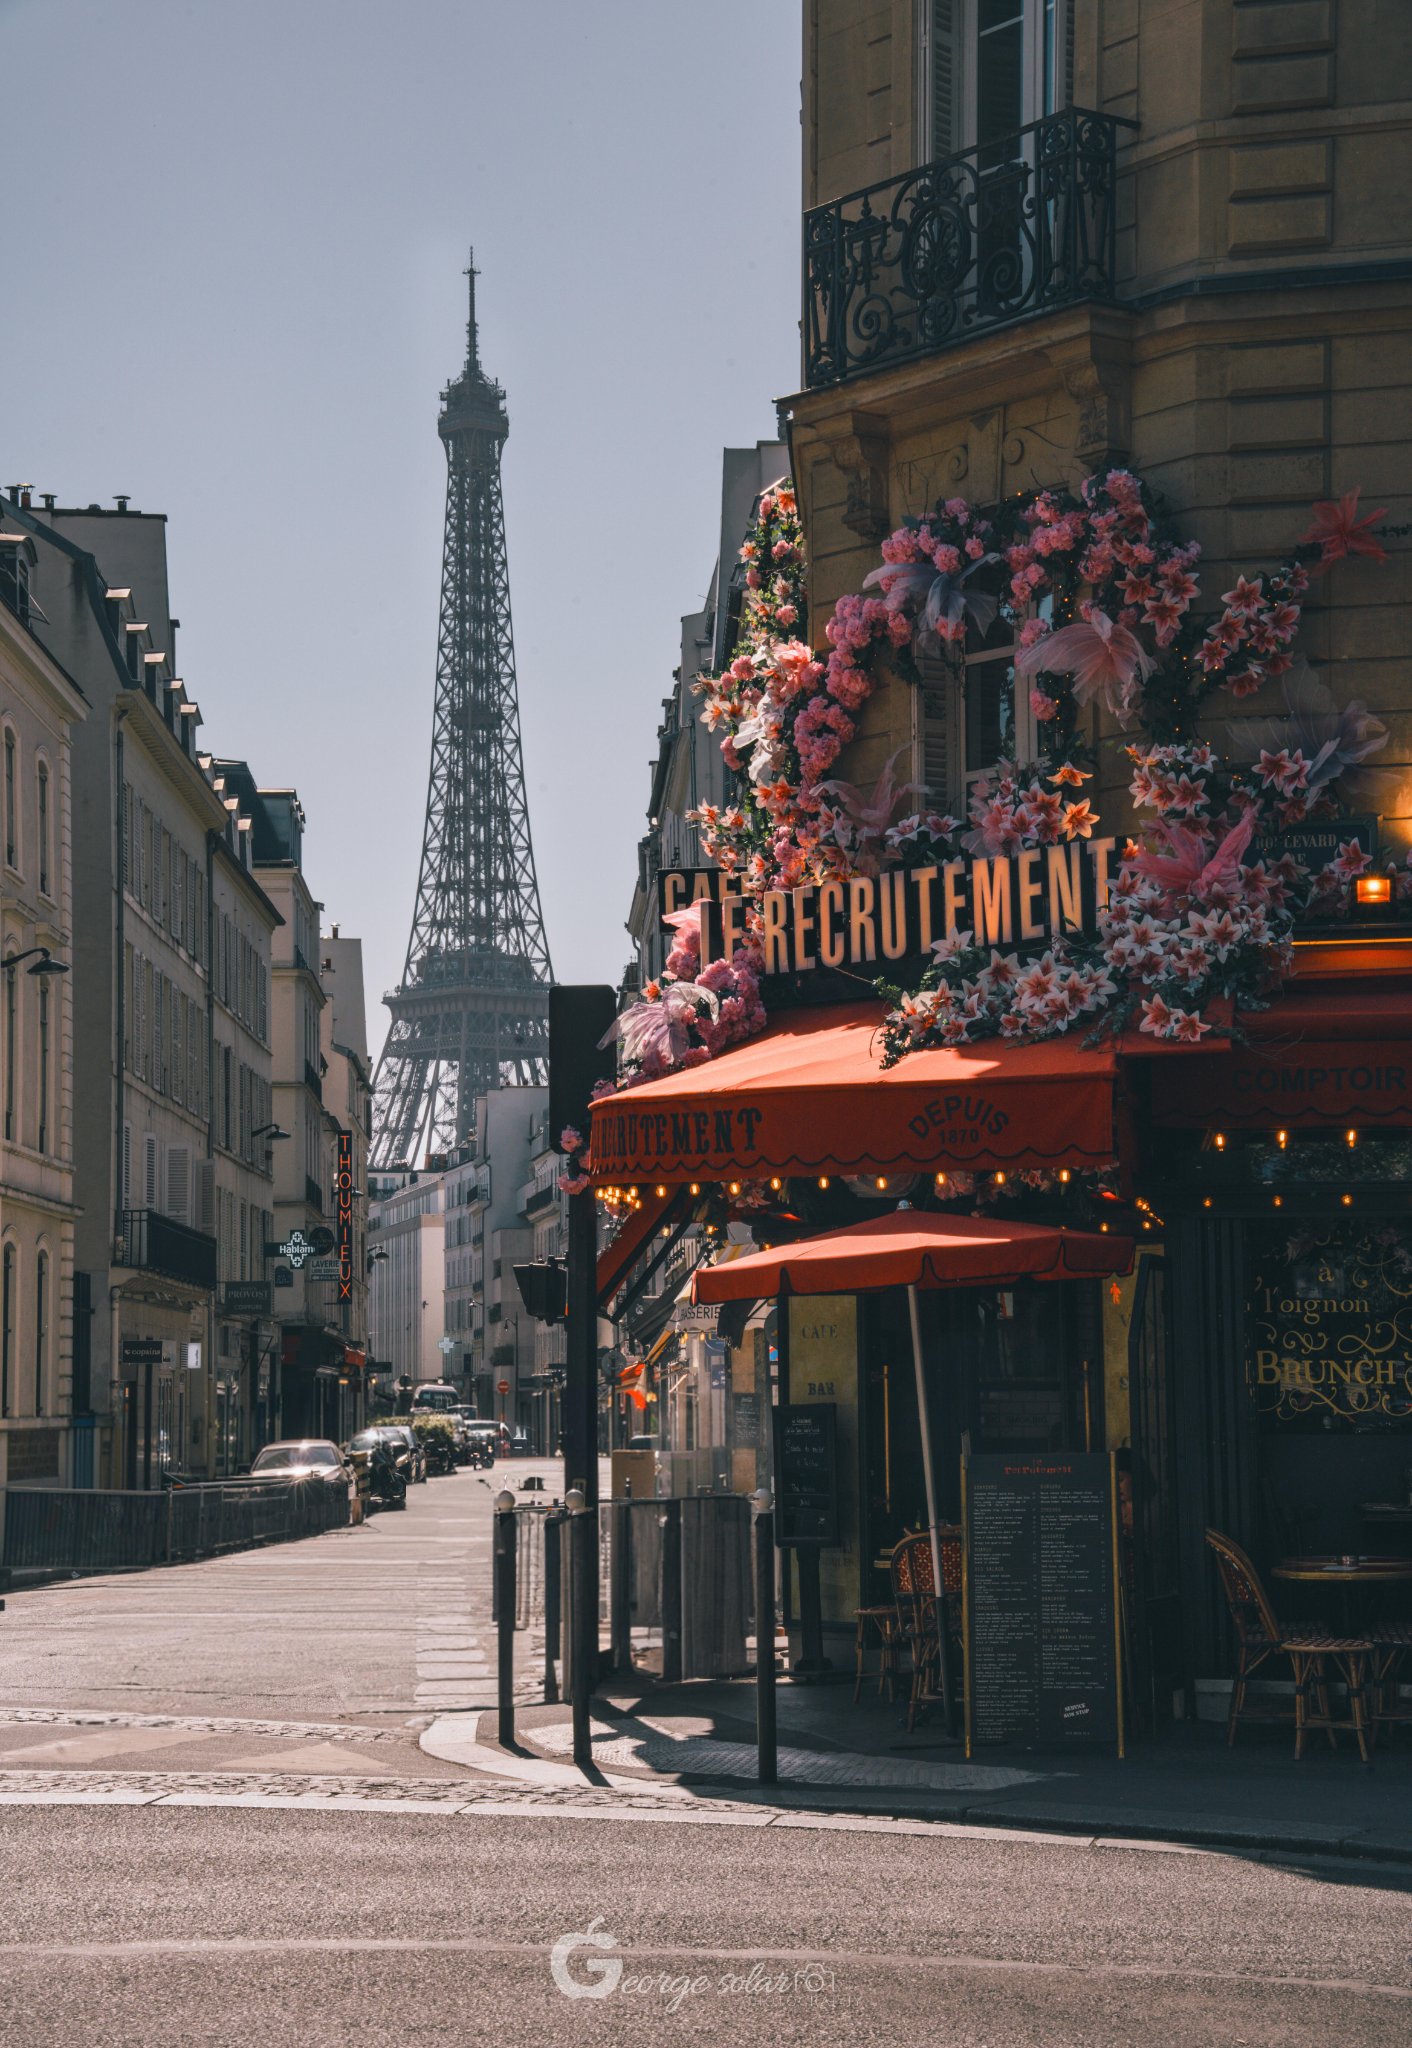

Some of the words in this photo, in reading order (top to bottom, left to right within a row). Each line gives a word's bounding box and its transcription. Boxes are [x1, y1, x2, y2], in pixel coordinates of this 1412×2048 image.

[1255, 834, 1337, 850] BOLEVARD
[764, 837, 1116, 975] RECRUTEMENT
[1231, 1065, 1407, 1094] COMPTOIR
[907, 1094, 1009, 1139] DEPUIS
[938, 1128, 979, 1144] 1870
[338, 1135, 352, 1299] THOUMIEUX
[311, 1259, 340, 1268] LAVERIE
[1255, 1349, 1397, 1386] BRUNCH
[807, 1382, 835, 1396] BAR
